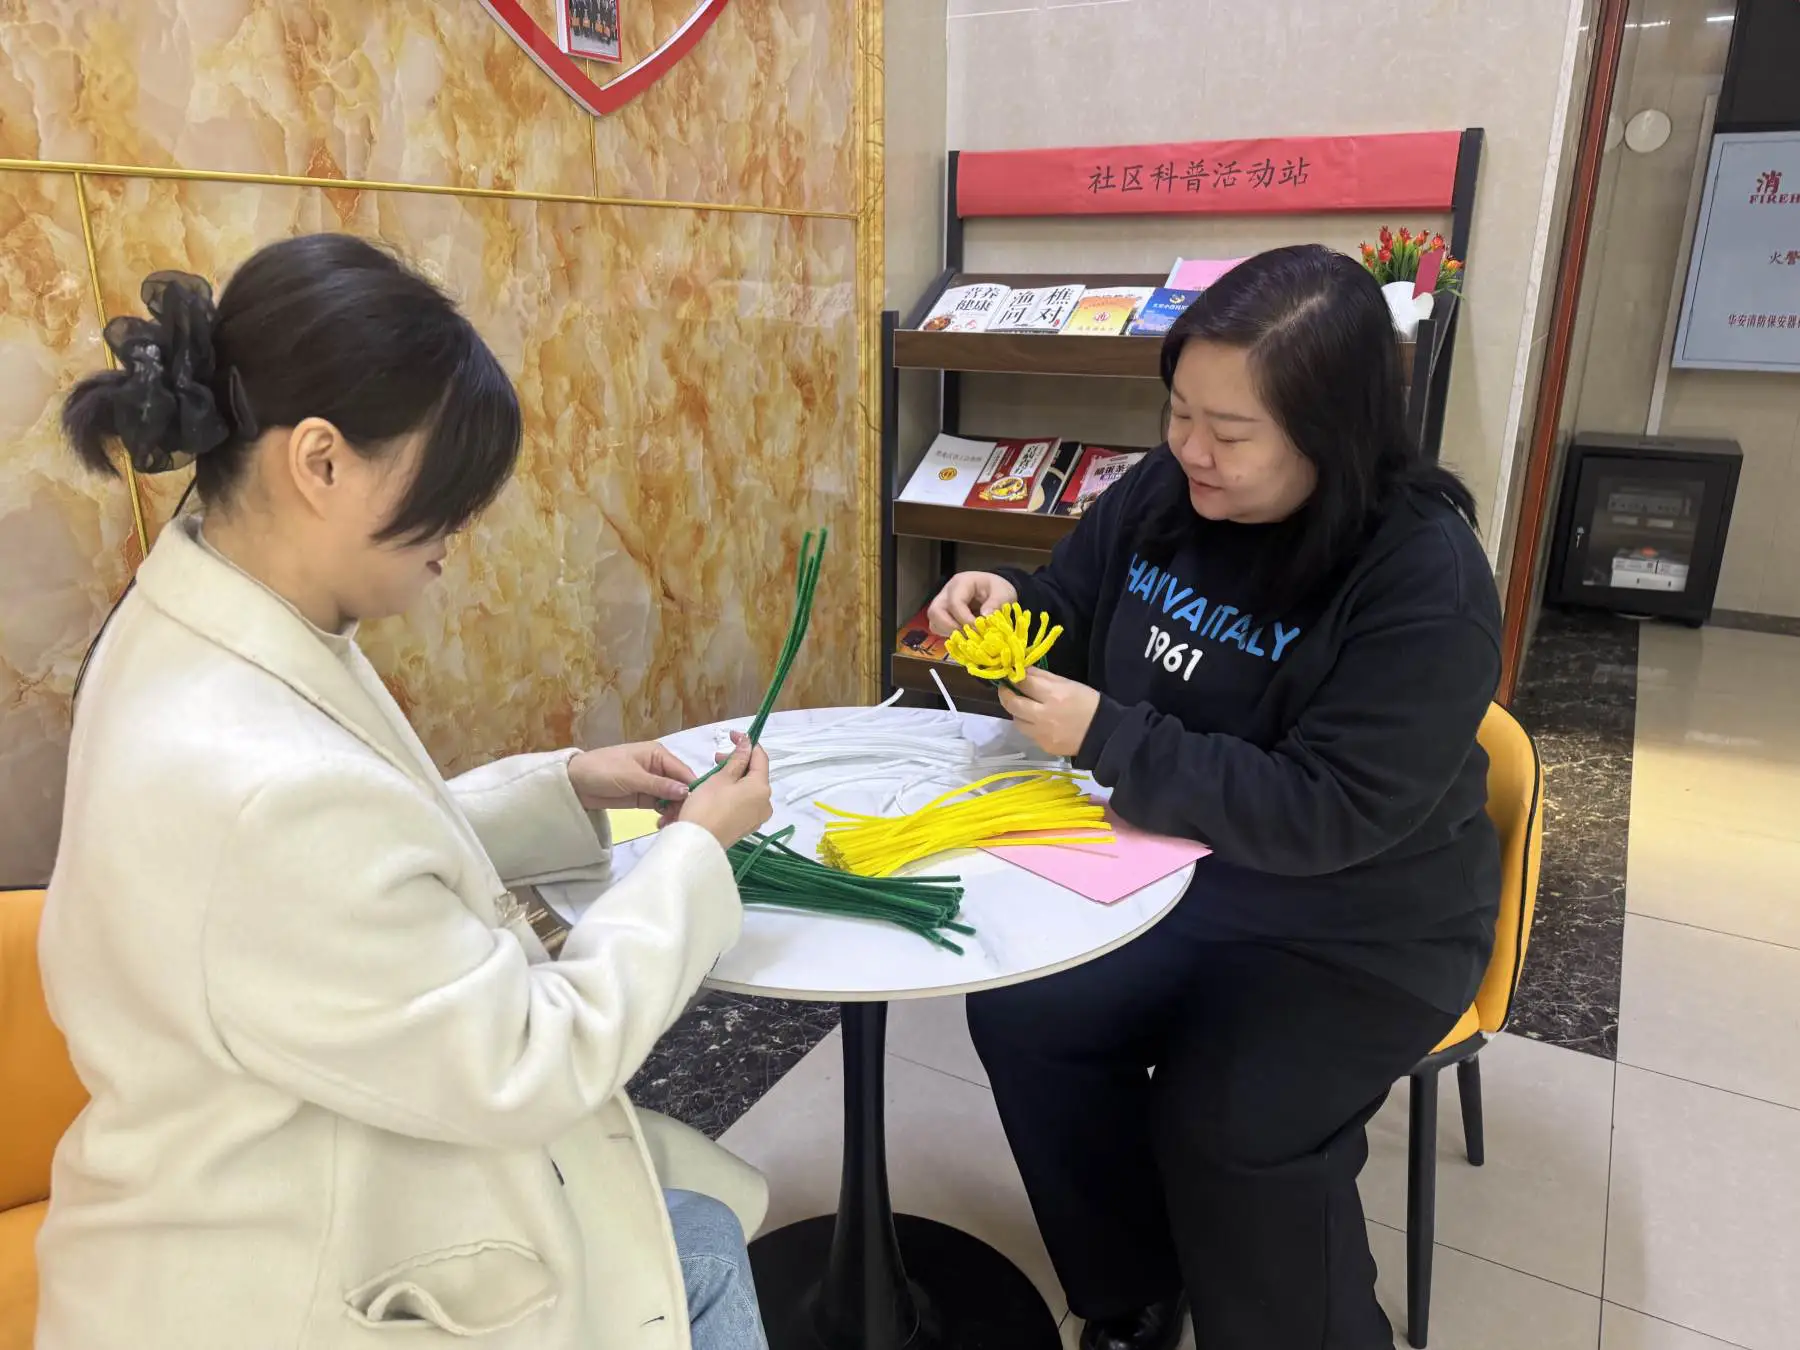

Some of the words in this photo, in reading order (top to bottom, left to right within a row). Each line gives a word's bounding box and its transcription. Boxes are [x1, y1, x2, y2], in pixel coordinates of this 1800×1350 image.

[1087, 156, 1311, 195] 社区科普活动站
[1756, 170, 1782, 194] 消
[965, 286, 999, 299] 营养
[955, 299, 994, 312] 健康
[1728, 313, 1800, 329] 华安消防保安器
[1144, 625, 1204, 682] 1961
